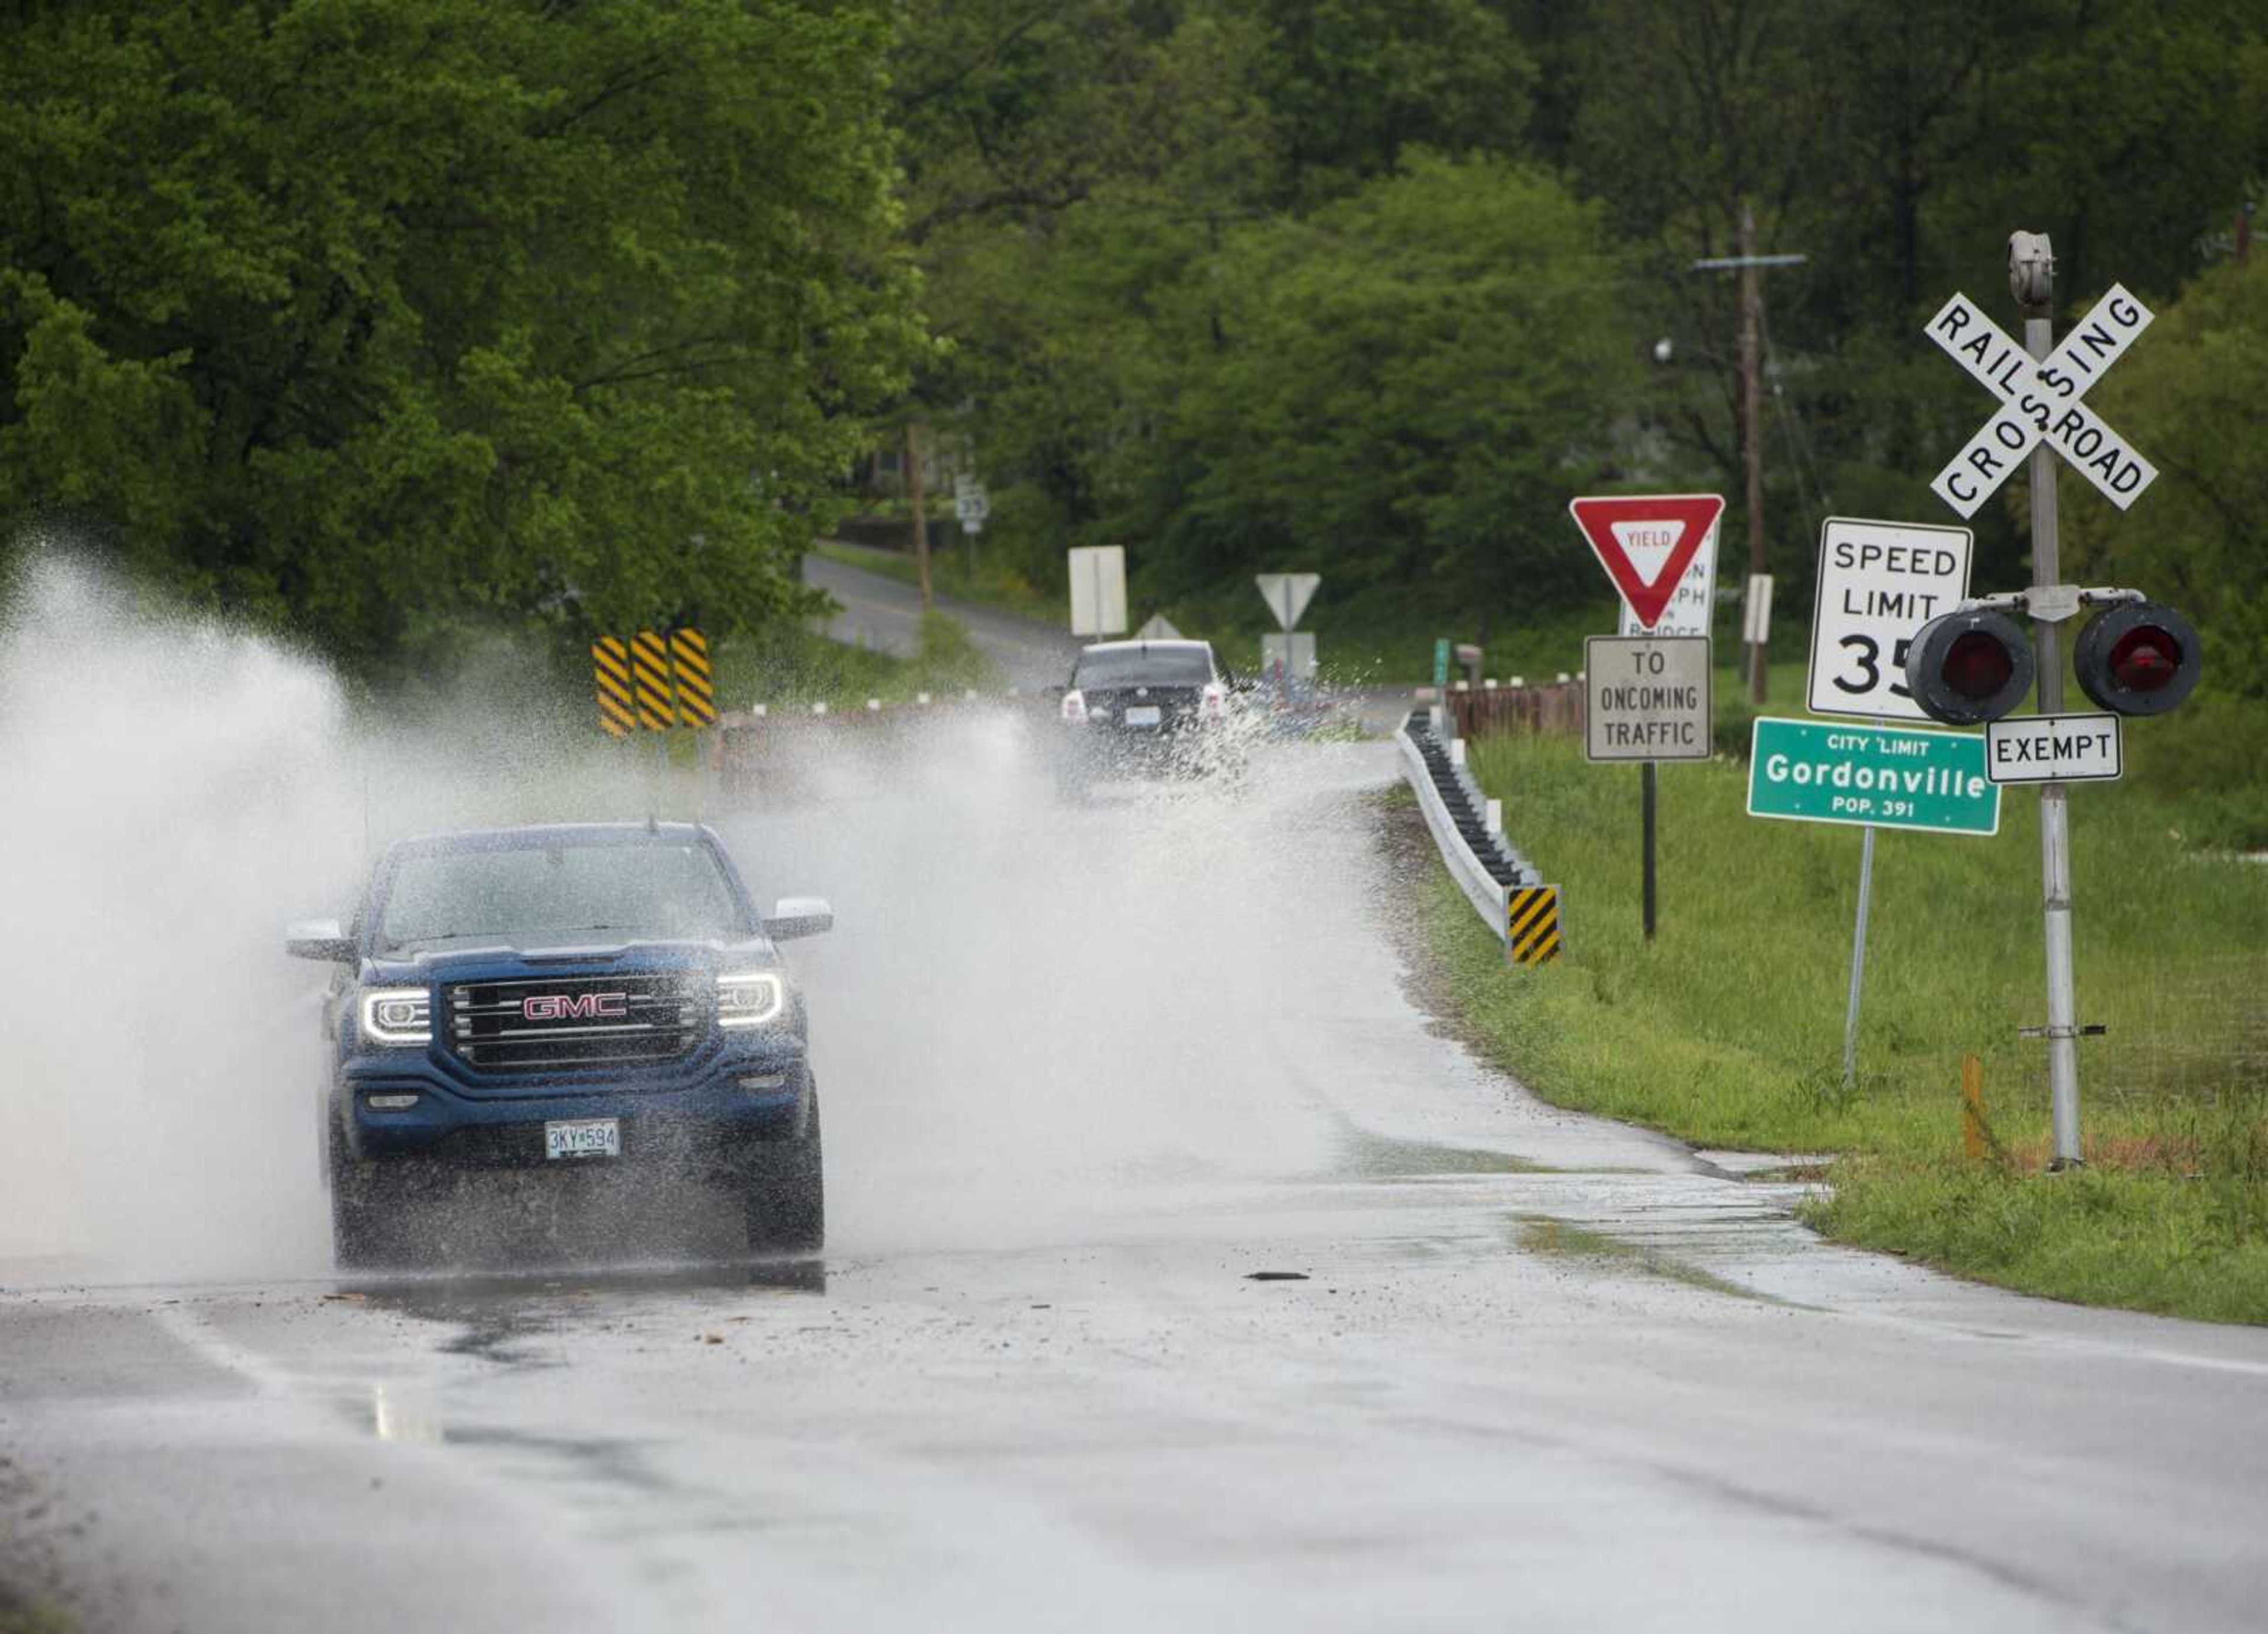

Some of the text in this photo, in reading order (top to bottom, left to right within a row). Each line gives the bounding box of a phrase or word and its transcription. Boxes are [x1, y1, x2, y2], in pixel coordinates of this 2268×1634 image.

[1628, 531, 1670, 546] YIELD
[1834, 542, 1956, 576] SPEED
[1844, 588, 1939, 620] LIMIT
[1632, 651, 1664, 674] TO
[1601, 686, 1697, 710] ONCOMING
[1604, 722, 1694, 746] TRAFFIC
[1827, 734, 1929, 756] CITY LIMIT
[1997, 734, 2110, 762] EXEMPT
[1766, 754, 1986, 798] Gordonville
[1832, 796, 1914, 817] POP. 391
[524, 992, 627, 1020] GMC
